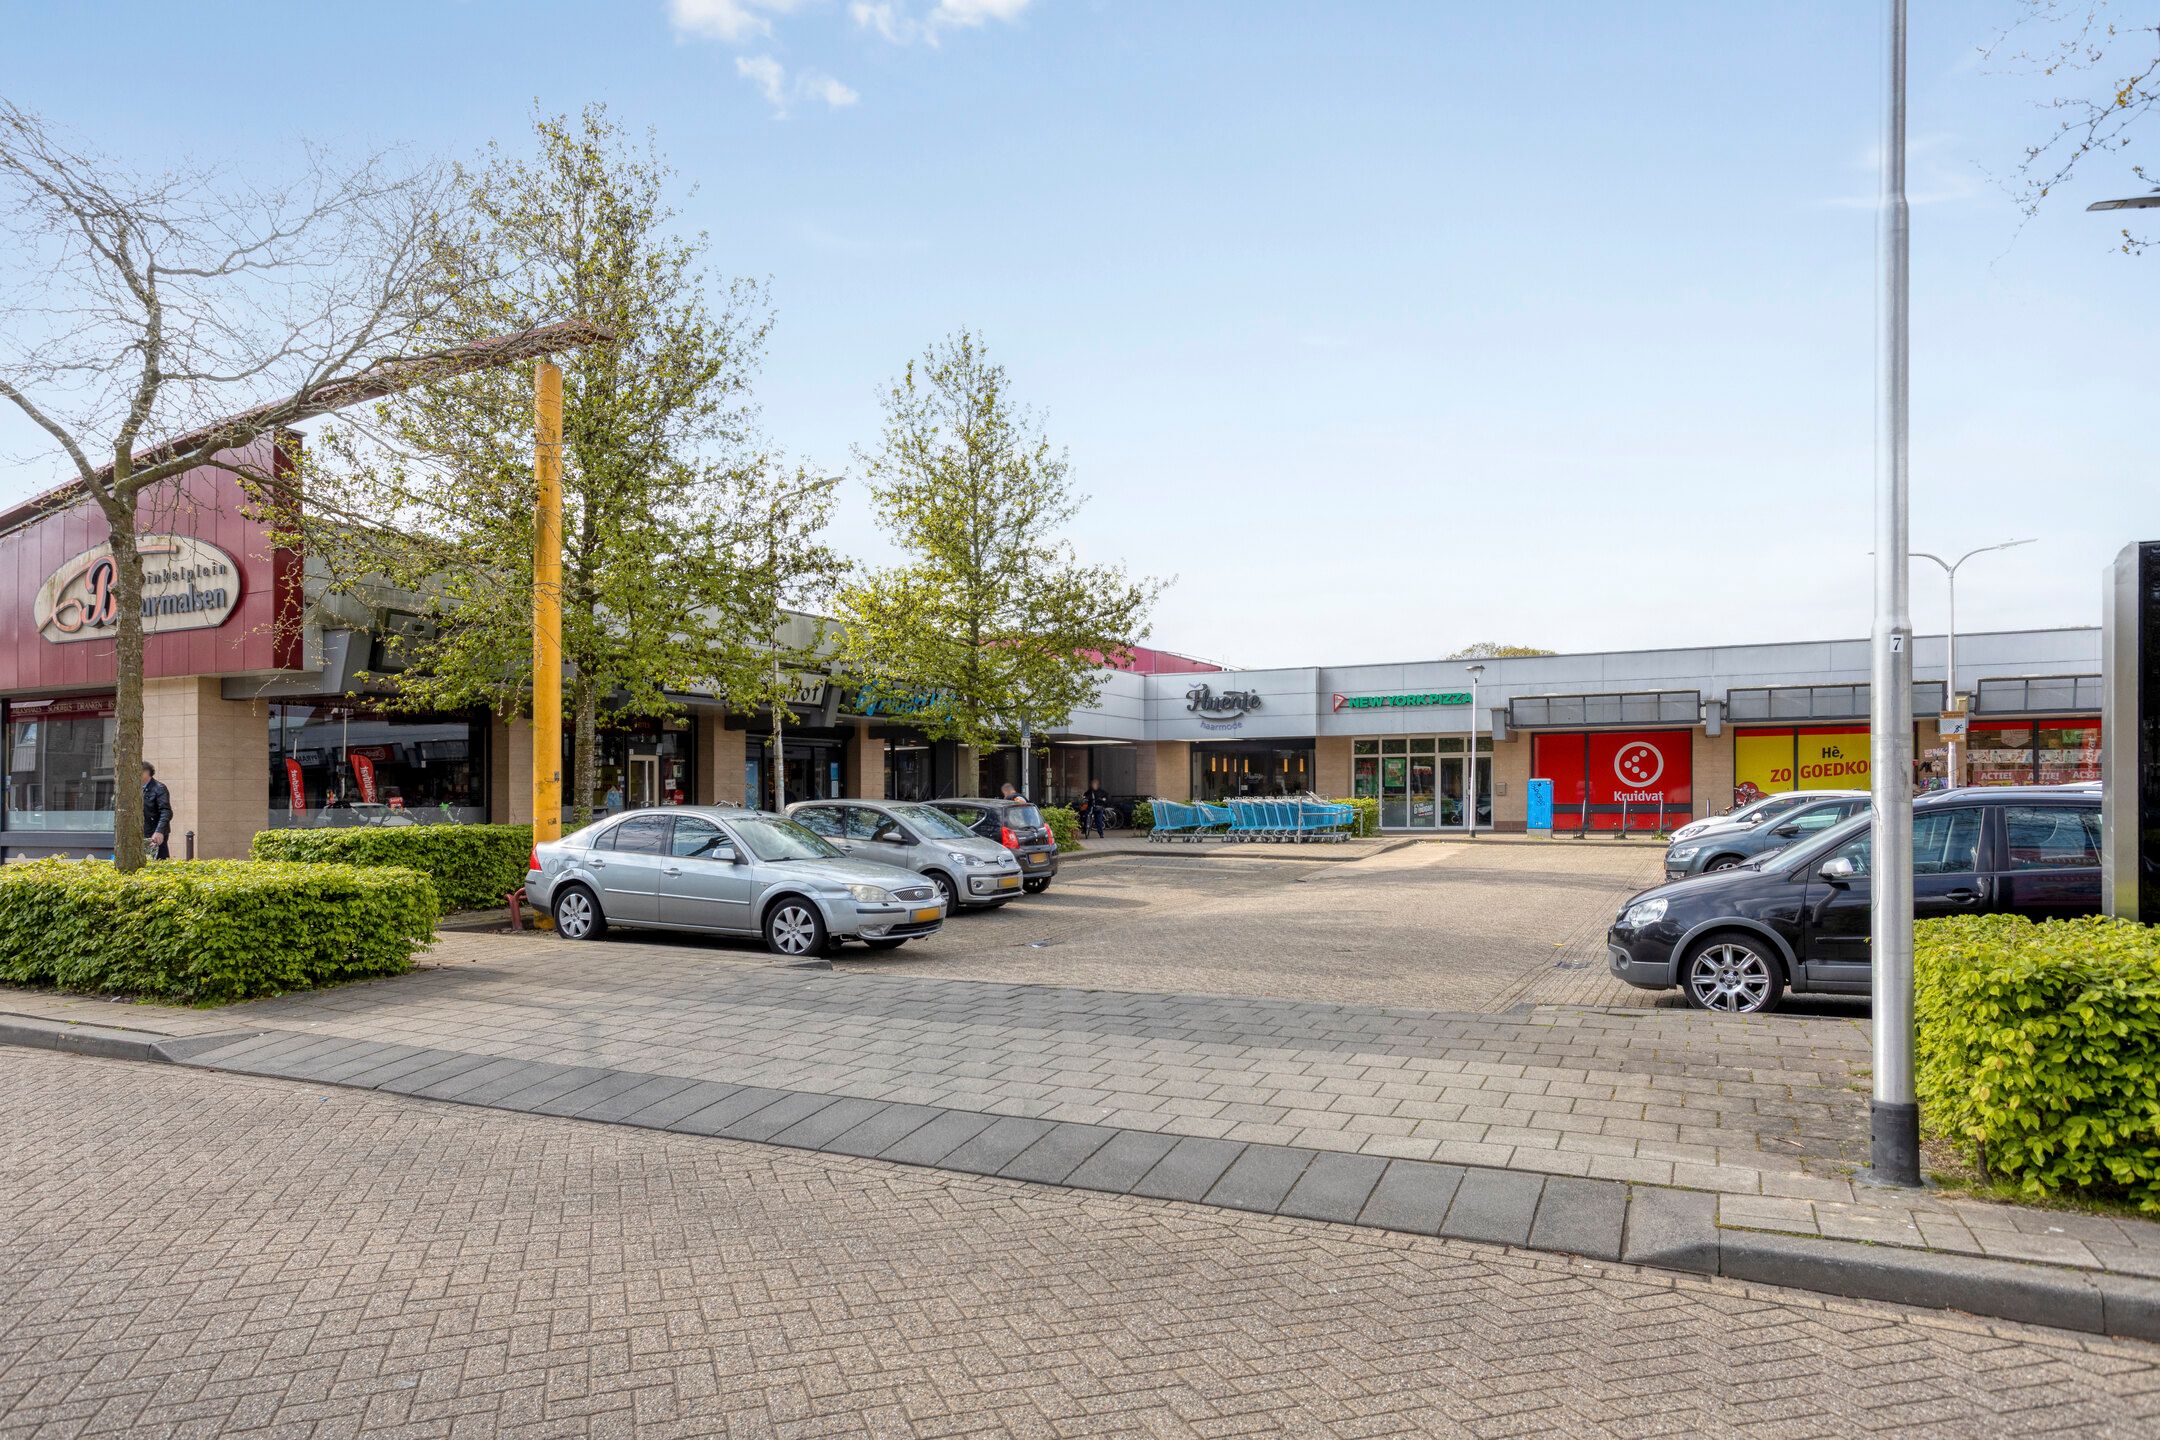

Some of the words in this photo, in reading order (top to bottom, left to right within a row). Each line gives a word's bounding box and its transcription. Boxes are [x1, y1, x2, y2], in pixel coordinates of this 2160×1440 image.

[142, 563, 226, 585] inkelplein
[1893, 638, 1901, 651] 7
[1349, 697, 1384, 708] NEW
[1387, 695, 1427, 706] YORK
[1429, 693, 1473, 705] PIZZA
[1201, 721, 1243, 731] haarmode
[1822, 745, 1844, 759] Hè,
[1770, 768, 1792, 783] ZO
[1800, 760, 1871, 779] GOEDKO
[1981, 772, 2012, 780] ACTIE!
[2027, 772, 2059, 780] ATIE!
[1613, 790, 1664, 801] Kruidvat
